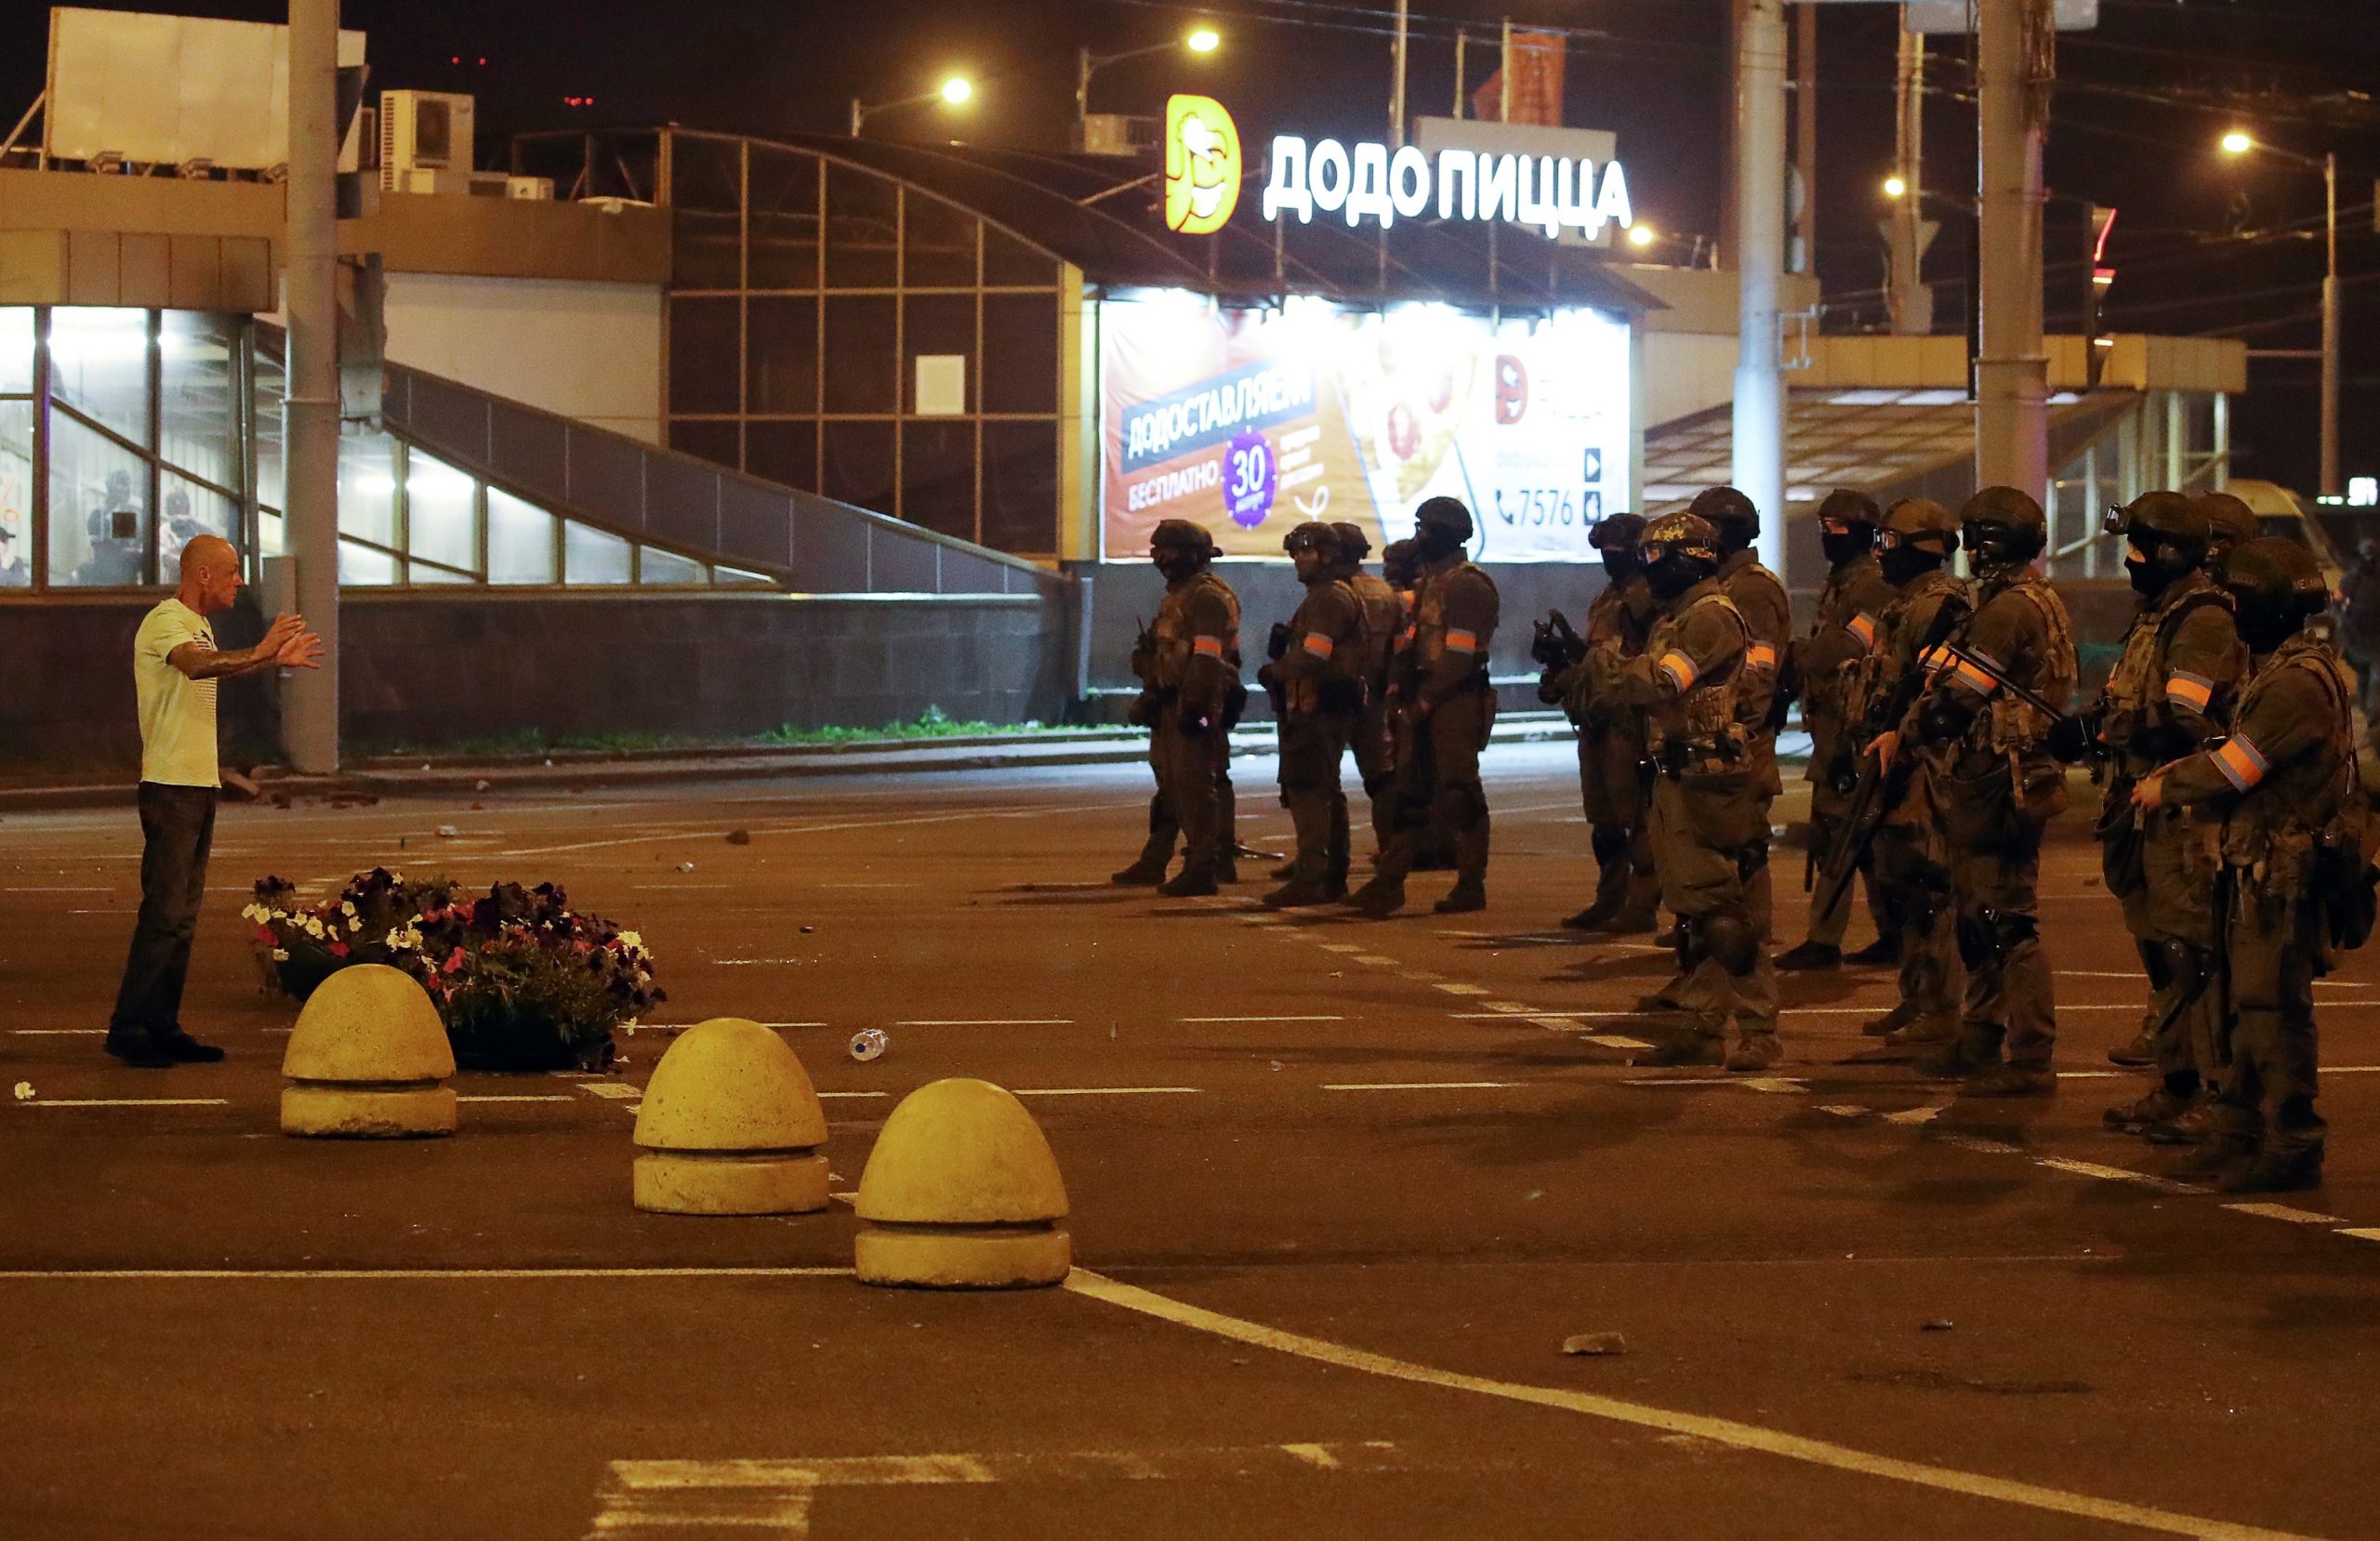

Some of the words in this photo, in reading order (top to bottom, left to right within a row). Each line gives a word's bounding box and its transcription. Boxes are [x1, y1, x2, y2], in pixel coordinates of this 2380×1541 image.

[1263, 135, 1430, 230] ДОДО
[1437, 149, 1633, 242] ПИЦЦА
[1128, 460, 1220, 512] БЕСПЛАТНО
[1232, 444, 1266, 497] 30
[1519, 489, 1573, 526] 7576
